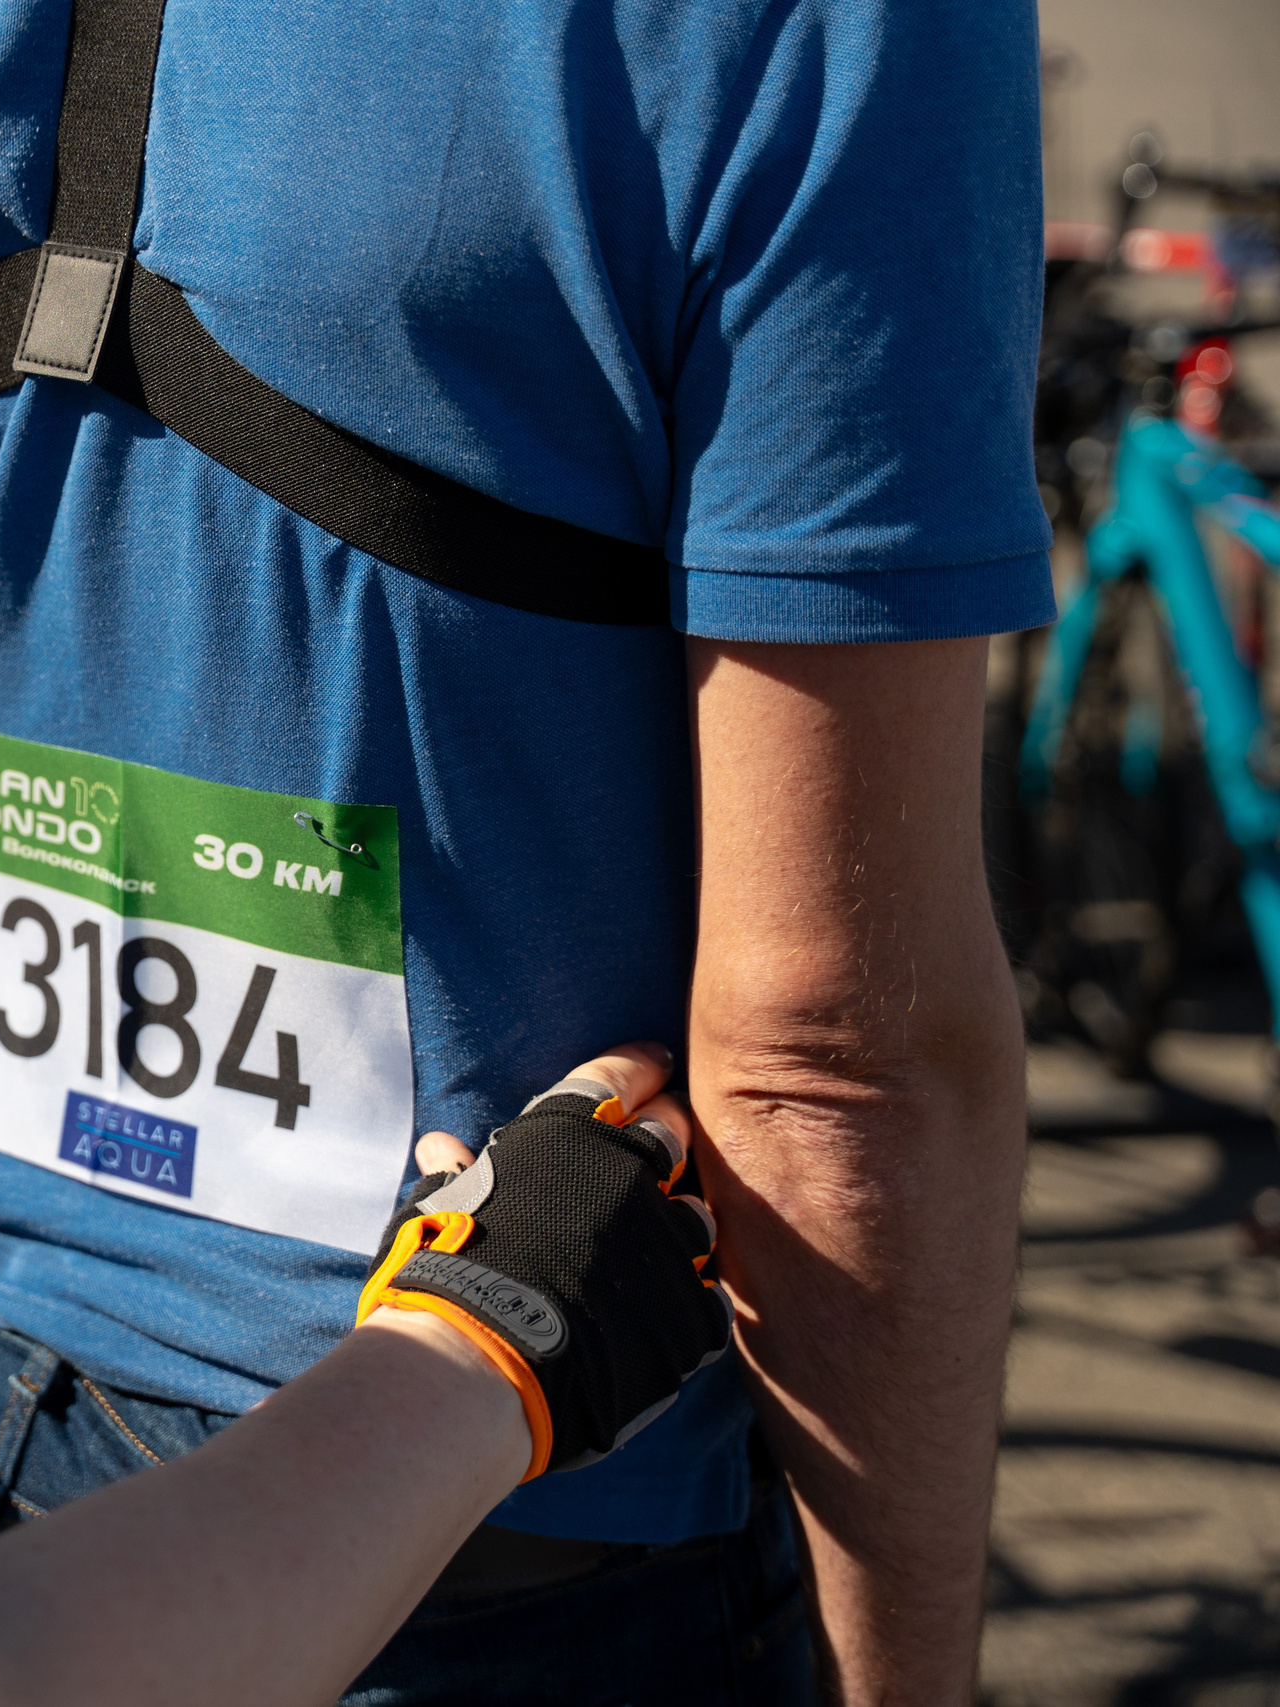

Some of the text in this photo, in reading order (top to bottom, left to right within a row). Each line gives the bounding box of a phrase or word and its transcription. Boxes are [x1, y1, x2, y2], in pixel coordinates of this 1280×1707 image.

[193, 833, 263, 880] 30
[76, 1101, 184, 1150] STELLAR
[72, 1133, 178, 1186] AQUA
